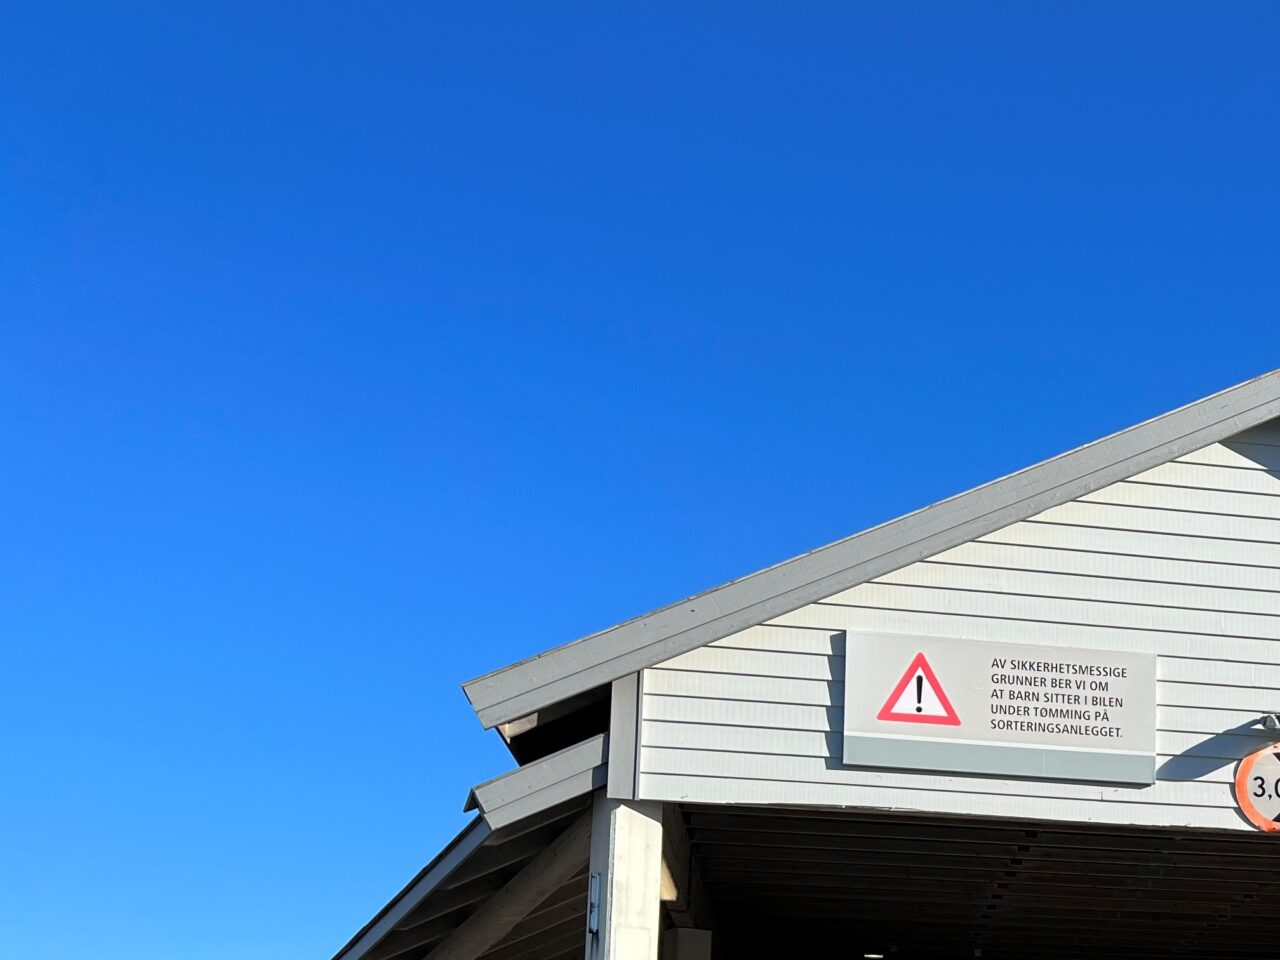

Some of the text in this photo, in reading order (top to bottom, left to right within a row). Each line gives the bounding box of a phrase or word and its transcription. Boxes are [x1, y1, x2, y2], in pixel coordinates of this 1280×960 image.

[991, 658, 1127, 678] AV SIKKERHETSMESSIGE
[991, 673, 1109, 692] GRUNNER BER VI OM
[990, 689, 1123, 708] AT BARN SITTER I BILEN
[990, 704, 1110, 722] UNDER TØMMING PÅ
[990, 718, 1123, 738] SORTERINGSANLEGGET.
